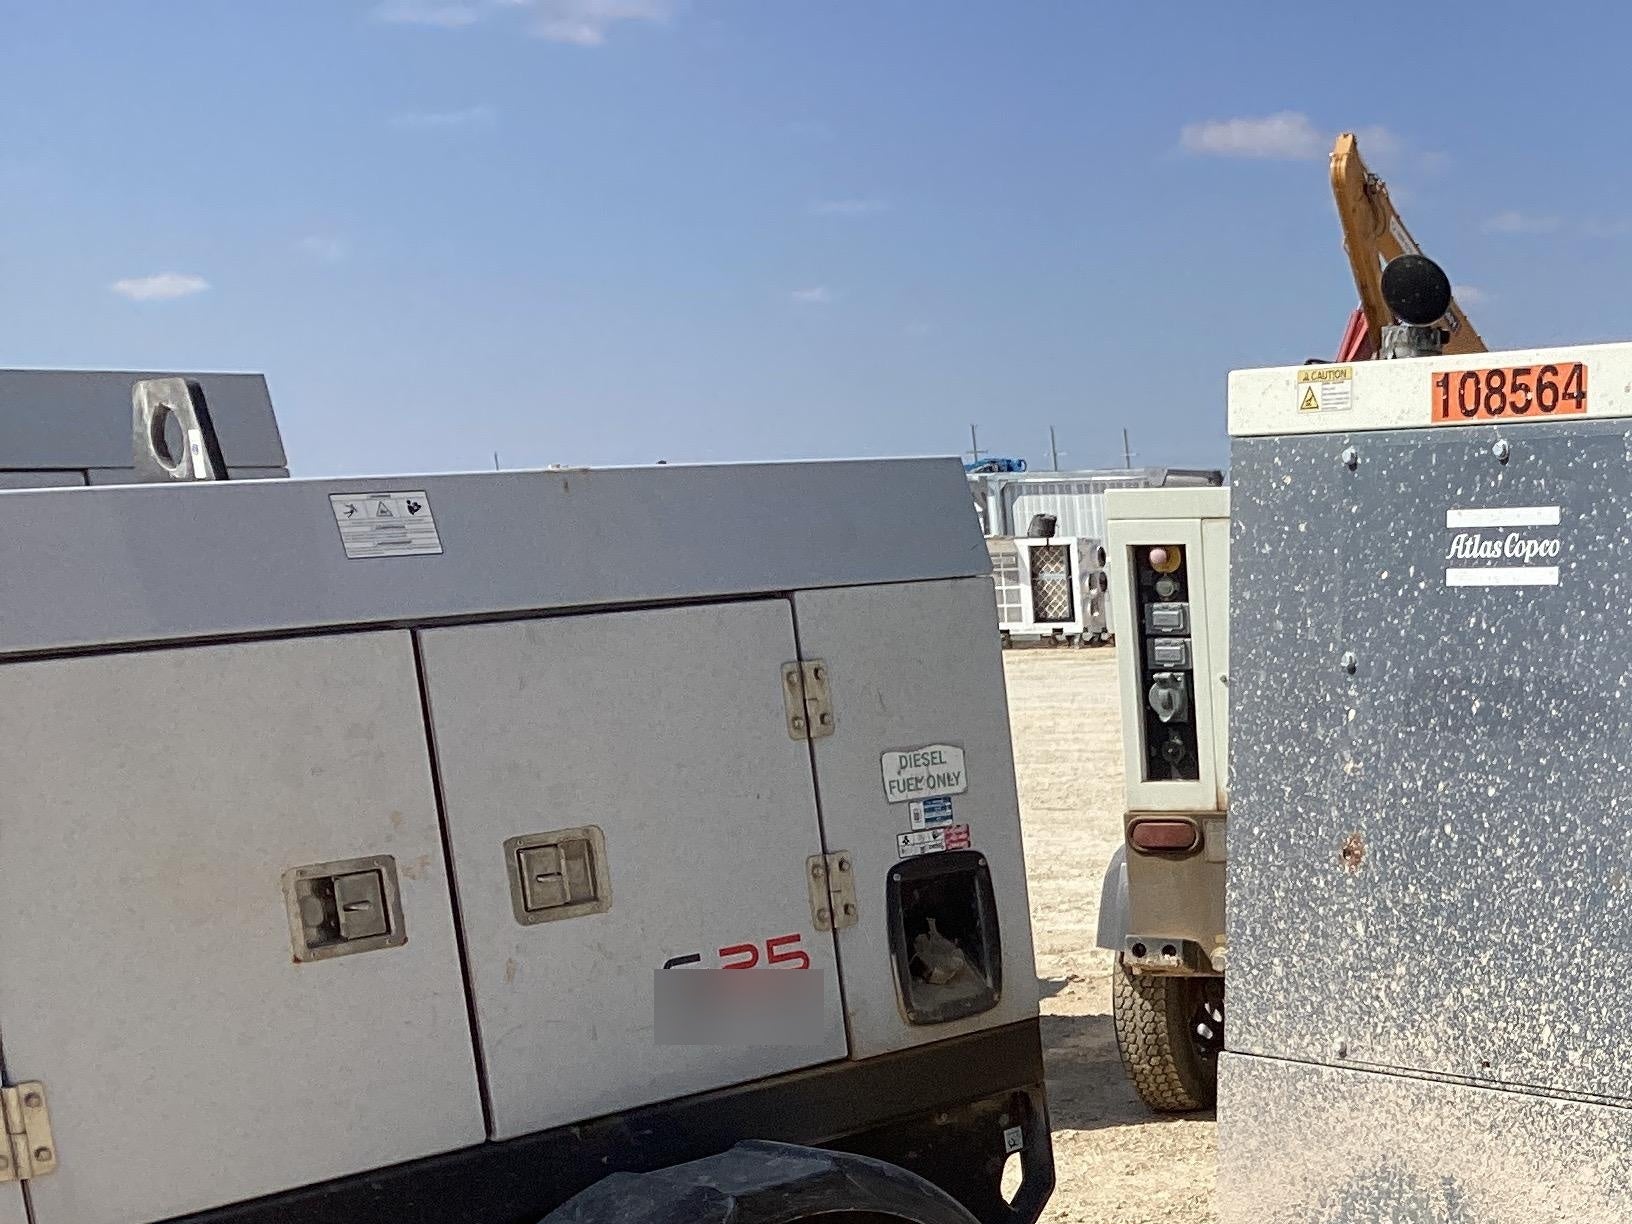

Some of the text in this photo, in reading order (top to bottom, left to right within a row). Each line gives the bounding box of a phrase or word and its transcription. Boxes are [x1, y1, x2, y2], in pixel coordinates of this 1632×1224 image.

[1311, 369, 1347, 381] CAUTION
[1436, 363, 1586, 418] 108564
[1446, 532, 1560, 563] Atlas Copco
[898, 750, 947, 770] DIESEL
[888, 771, 961, 795] FUEL ONLY
